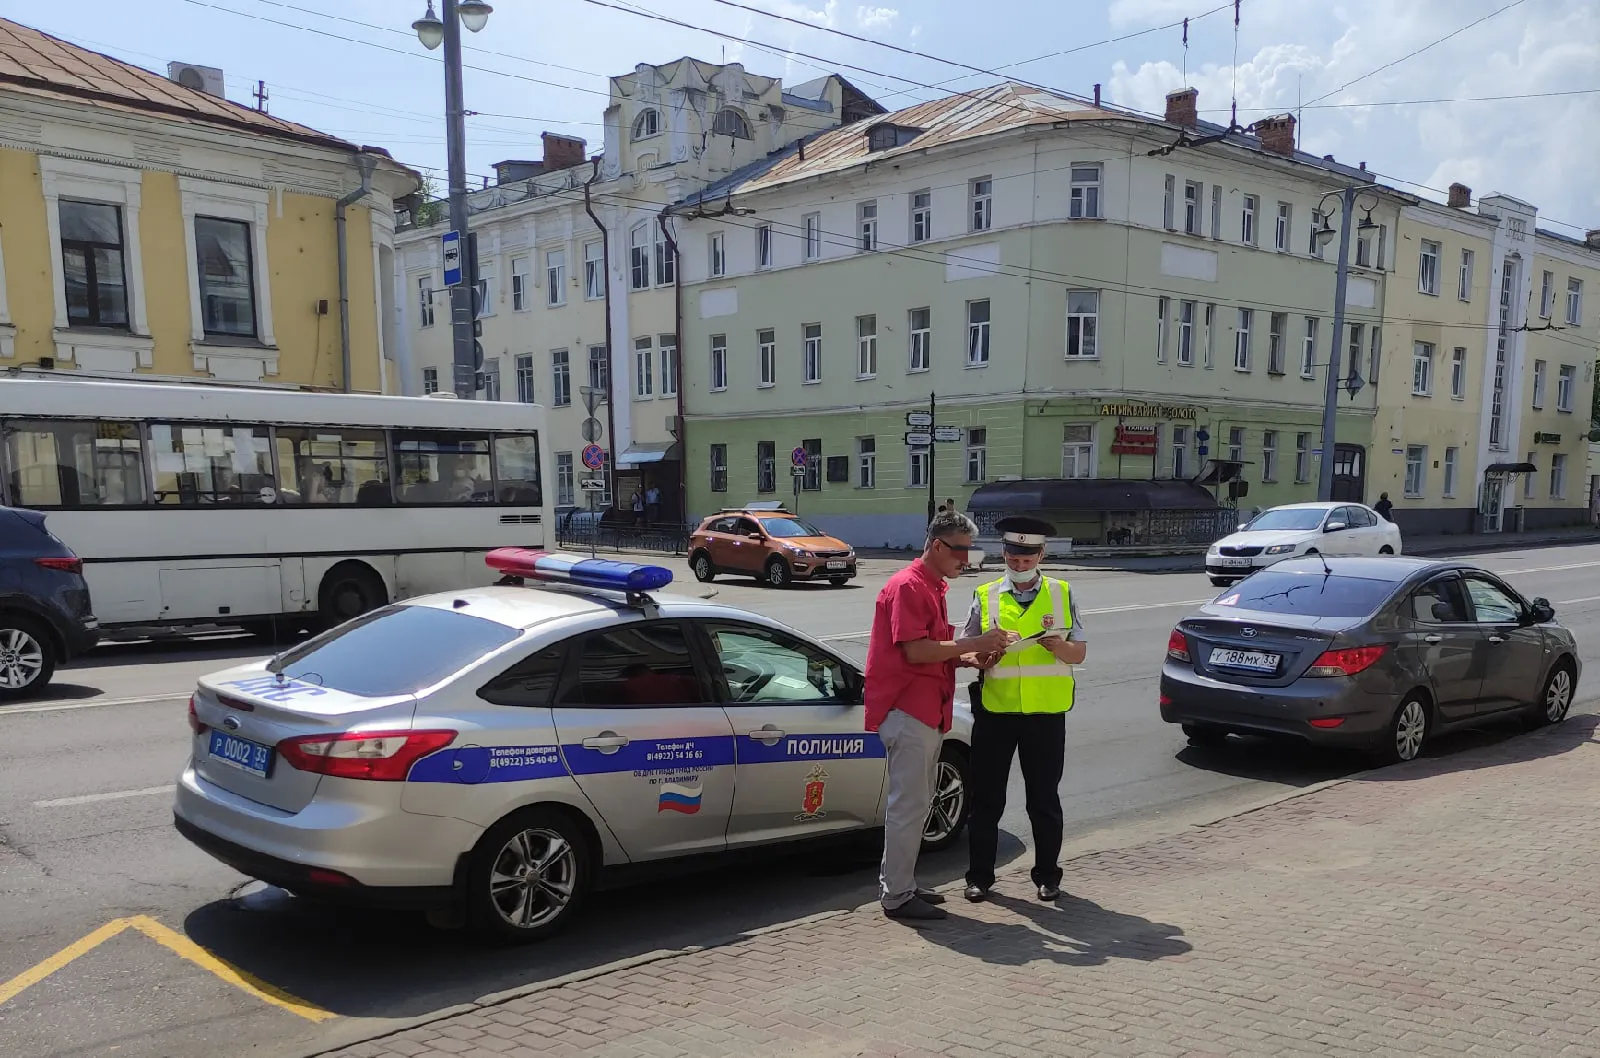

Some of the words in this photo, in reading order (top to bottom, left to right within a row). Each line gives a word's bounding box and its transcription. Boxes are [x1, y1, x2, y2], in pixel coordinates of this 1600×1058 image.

[224, 738, 250, 763] 0002
[491, 748, 524, 757] Телефон
[525, 746, 557, 756] доверия
[656, 743, 684, 751] Телефон
[787, 739, 864, 757] ПОЛИЦИЯ
[490, 757, 523, 768] 8(4922)
